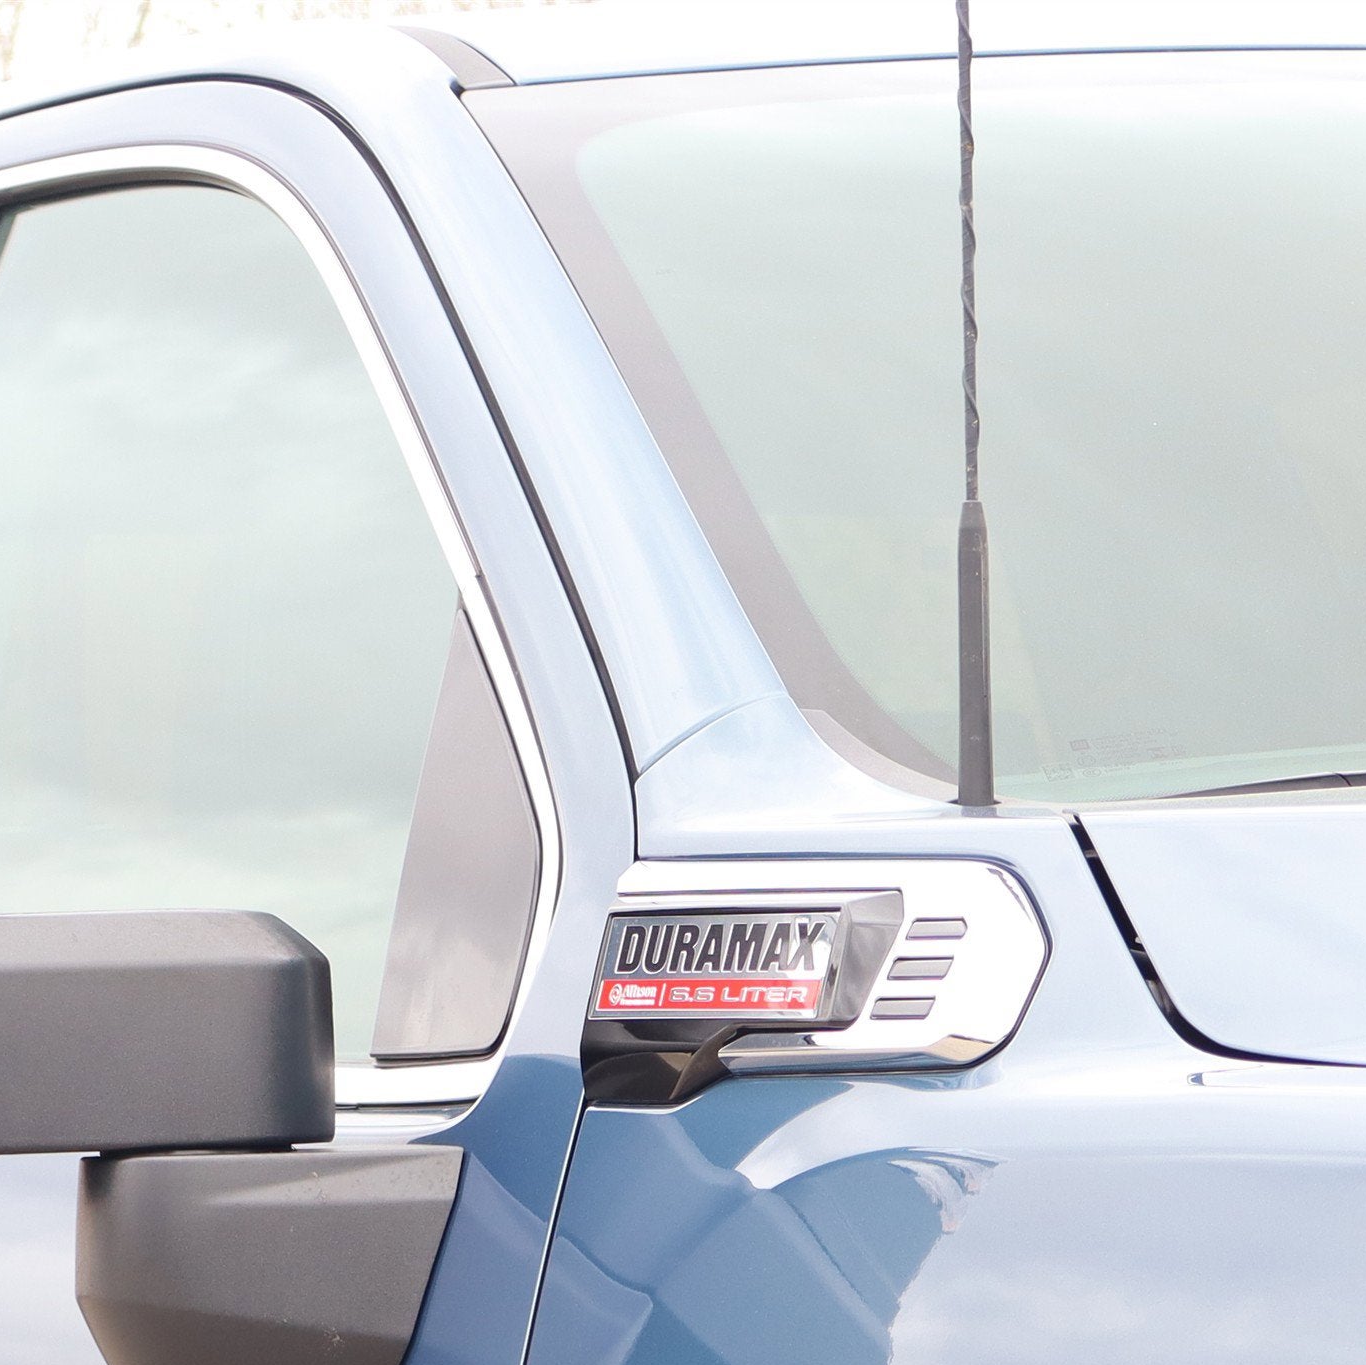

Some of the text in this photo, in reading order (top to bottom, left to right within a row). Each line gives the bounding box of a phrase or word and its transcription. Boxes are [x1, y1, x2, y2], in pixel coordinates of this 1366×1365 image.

[614, 920, 826, 975] DURAMAX
[669, 986, 808, 1003] 6.6 LITER
